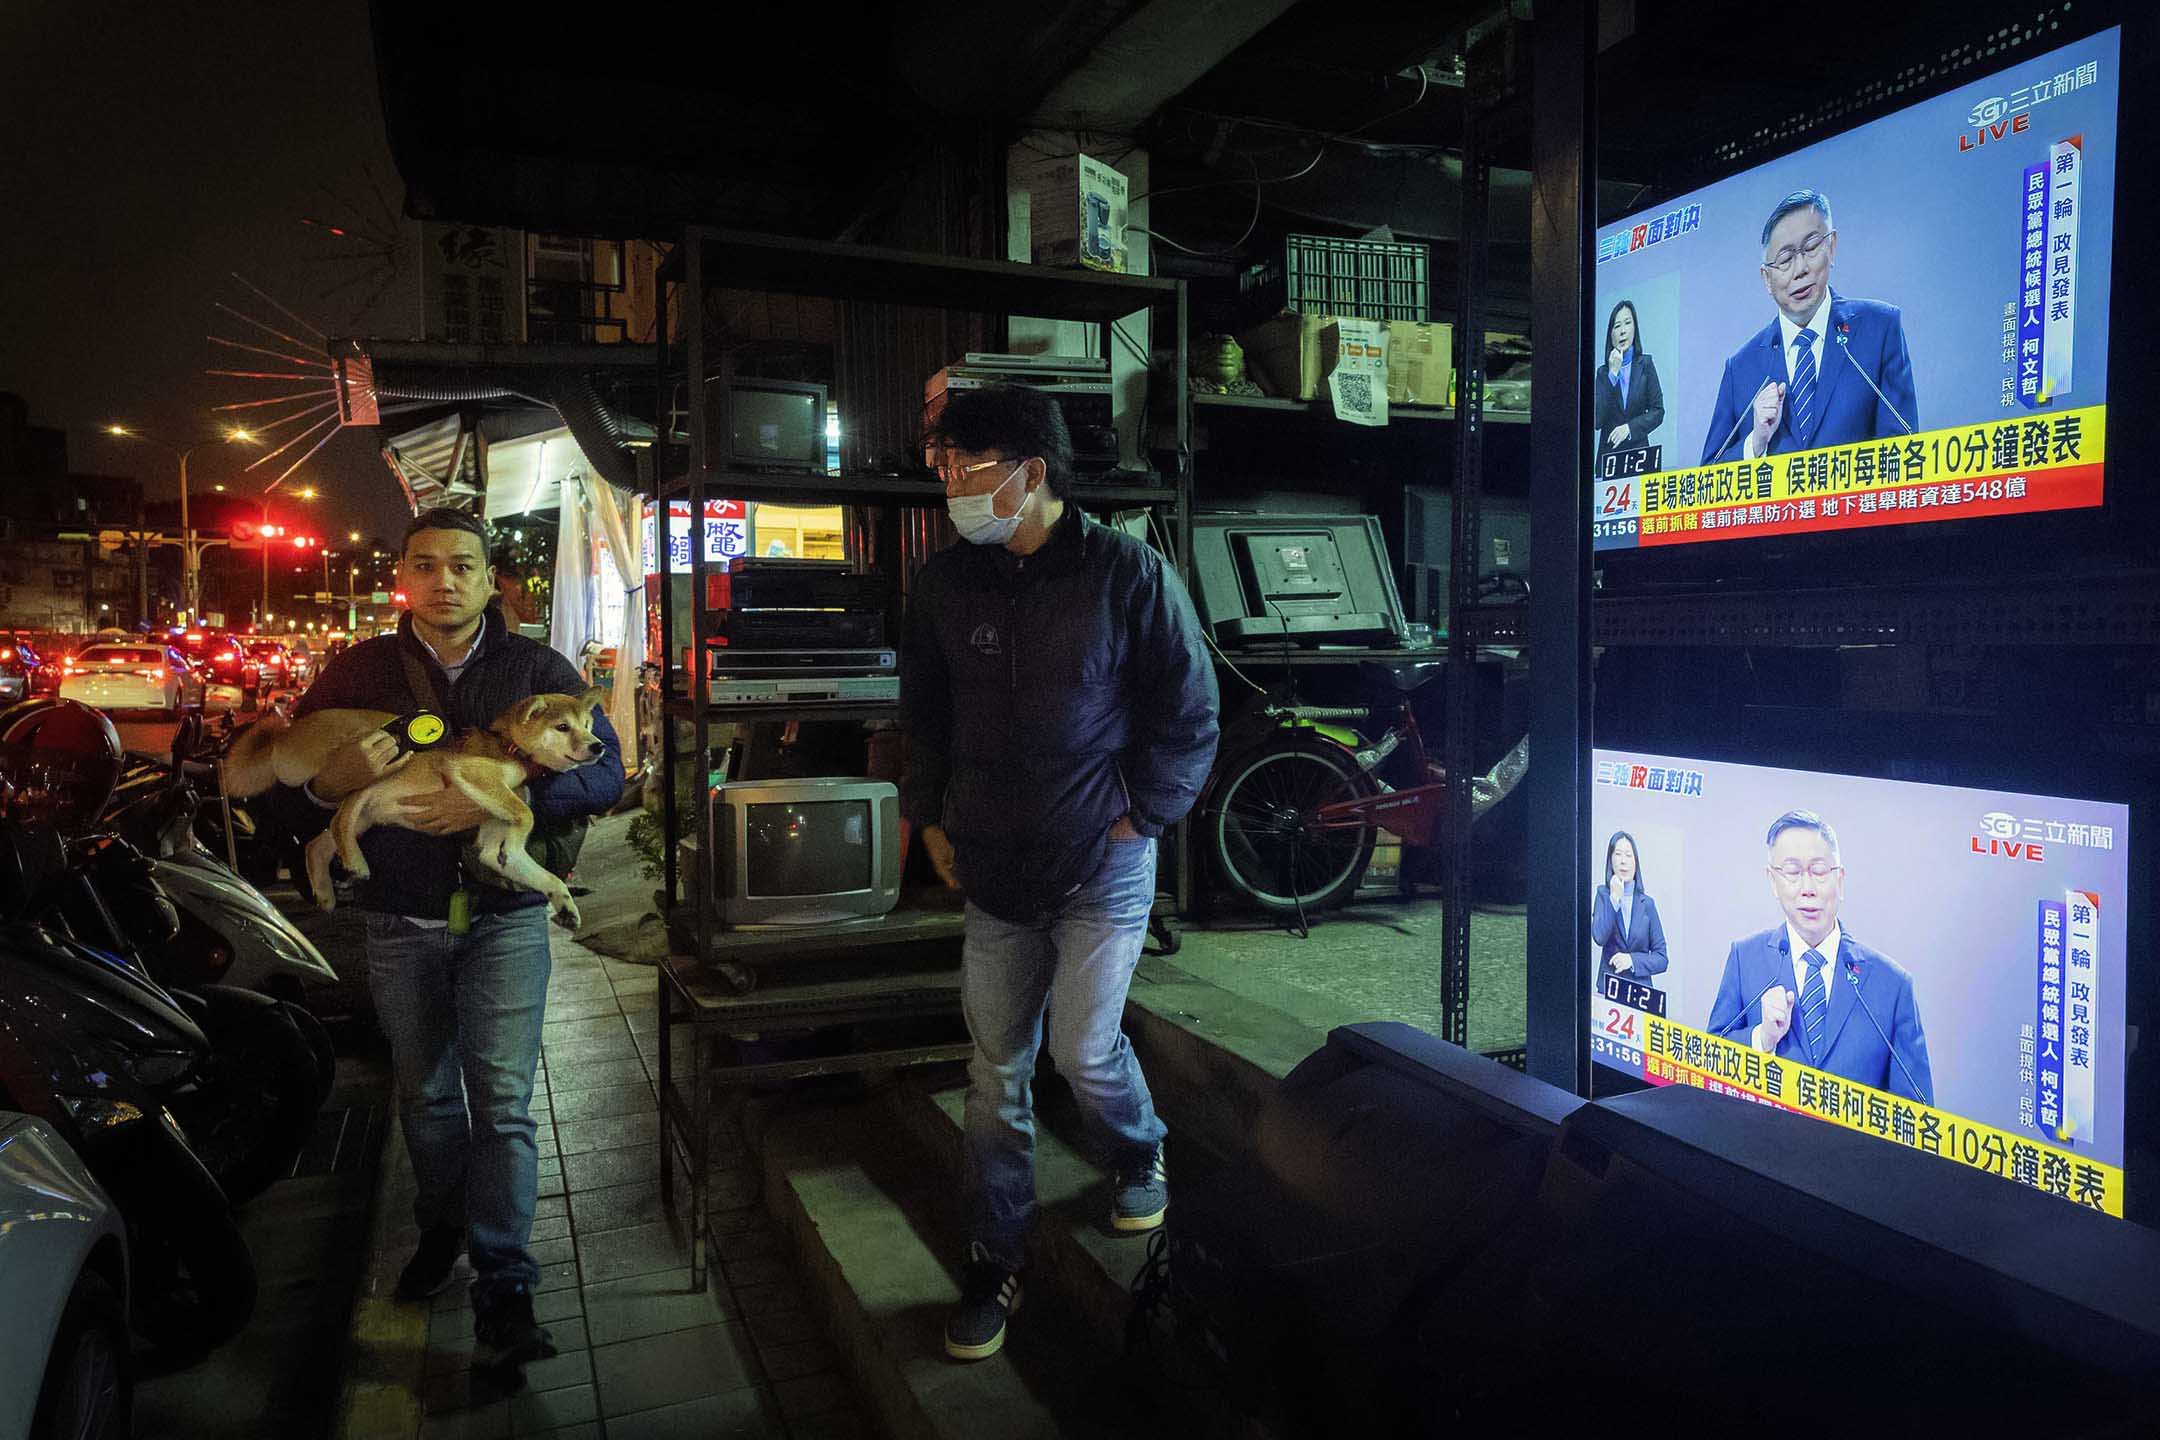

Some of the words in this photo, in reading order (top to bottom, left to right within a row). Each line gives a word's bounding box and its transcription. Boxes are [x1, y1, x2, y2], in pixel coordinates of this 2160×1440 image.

[2009, 60, 2098, 113] 三立新聞
[1959, 113, 2030, 152] LIVE
[2053, 152, 2075, 220] 第一輪
[2022, 172, 2045, 327] 民眾黨總統候選人
[2050, 233, 2072, 322] 政見發表
[2020, 339, 2039, 396] 柯文哲
[1605, 449, 1661, 477] 01:21
[1645, 461, 1774, 512] 首場總統政見會
[1786, 415, 2083, 496] 侯賴柯每輪各10分鐘發表
[1603, 484, 1631, 514] 24
[1641, 515, 1698, 535] 選前抓賭
[1701, 500, 1816, 529] 選前掃黑防介選
[1821, 476, 2027, 517] 地下選舉賭資達548億
[1970, 835, 2045, 862] LIVE
[2022, 818, 2113, 850] 三立新聞
[2071, 904, 2092, 969] 第一輪
[1605, 1008, 1634, 1040] 24
[1606, 977, 1664, 1015] 01:21
[2069, 981, 2090, 1069] 政見發表
[1646, 1056, 1705, 1089] 選前抓賭
[2040, 1068, 2059, 1127] 柯文哲
[1649, 1020, 1784, 1098] 首場總統政見會
[1796, 1069, 2106, 1213] 侯賴柯每輪各10分鐘發表
